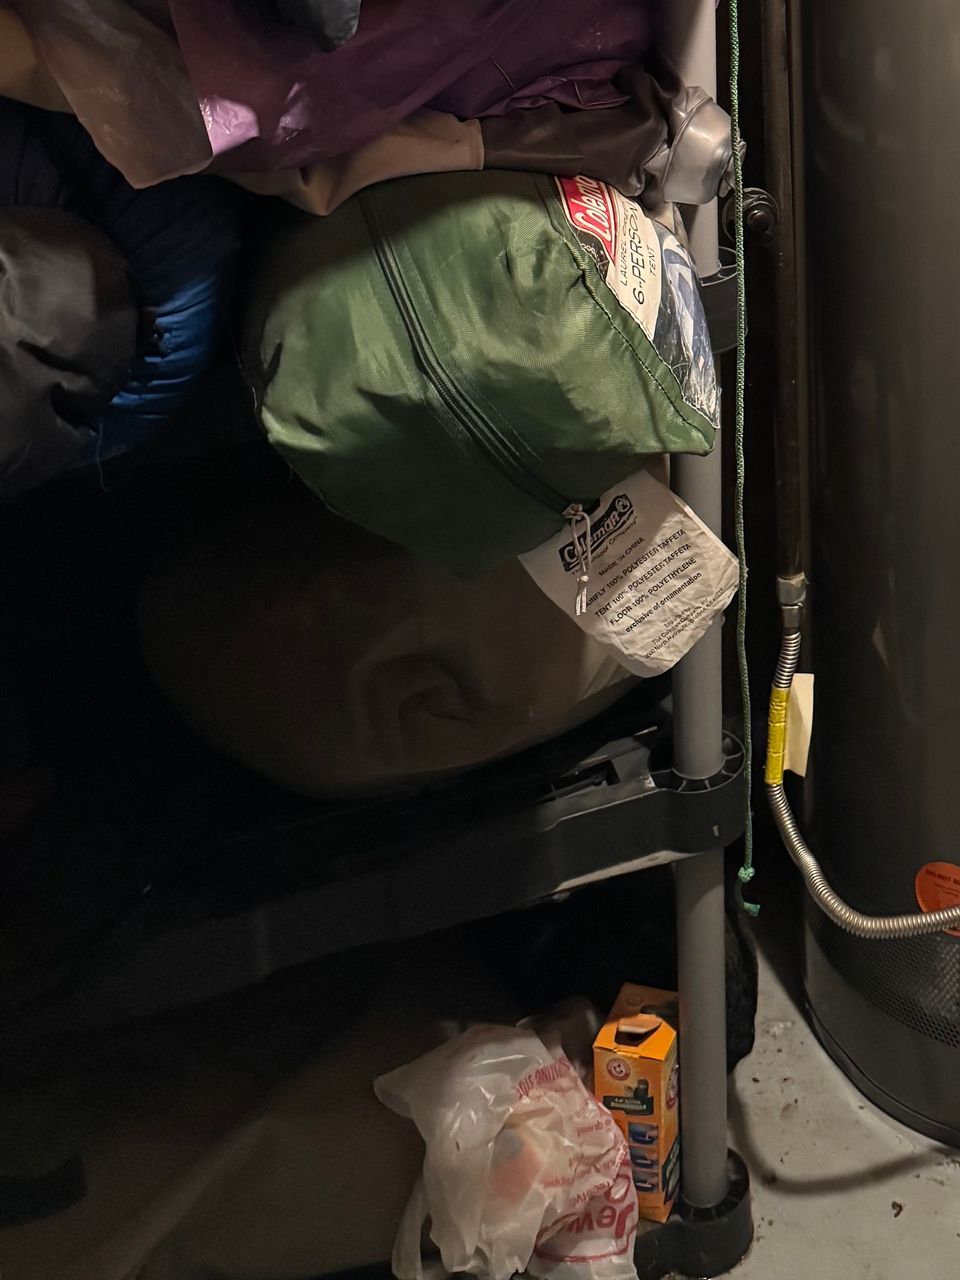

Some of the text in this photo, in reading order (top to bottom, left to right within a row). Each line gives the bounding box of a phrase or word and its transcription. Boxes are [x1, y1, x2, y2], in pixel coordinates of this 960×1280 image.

[620, 240, 628, 286] LAUREL
[647, 245, 656, 276] TENT
[585, 588, 606, 608] AINFLY
[623, 547, 660, 574] POLYESTER
[660, 529, 686, 549] TAFFETA
[626, 537, 646, 554] CHINA
[595, 602, 612, 617] TENT
[664, 544, 691, 564] TAFFETA
[610, 607, 632, 625] FLOOR
[648, 558, 696, 595] POLYETHYLENE
[626, 610, 653, 632] exclusive
[661, 572, 702, 606] ornamentation
